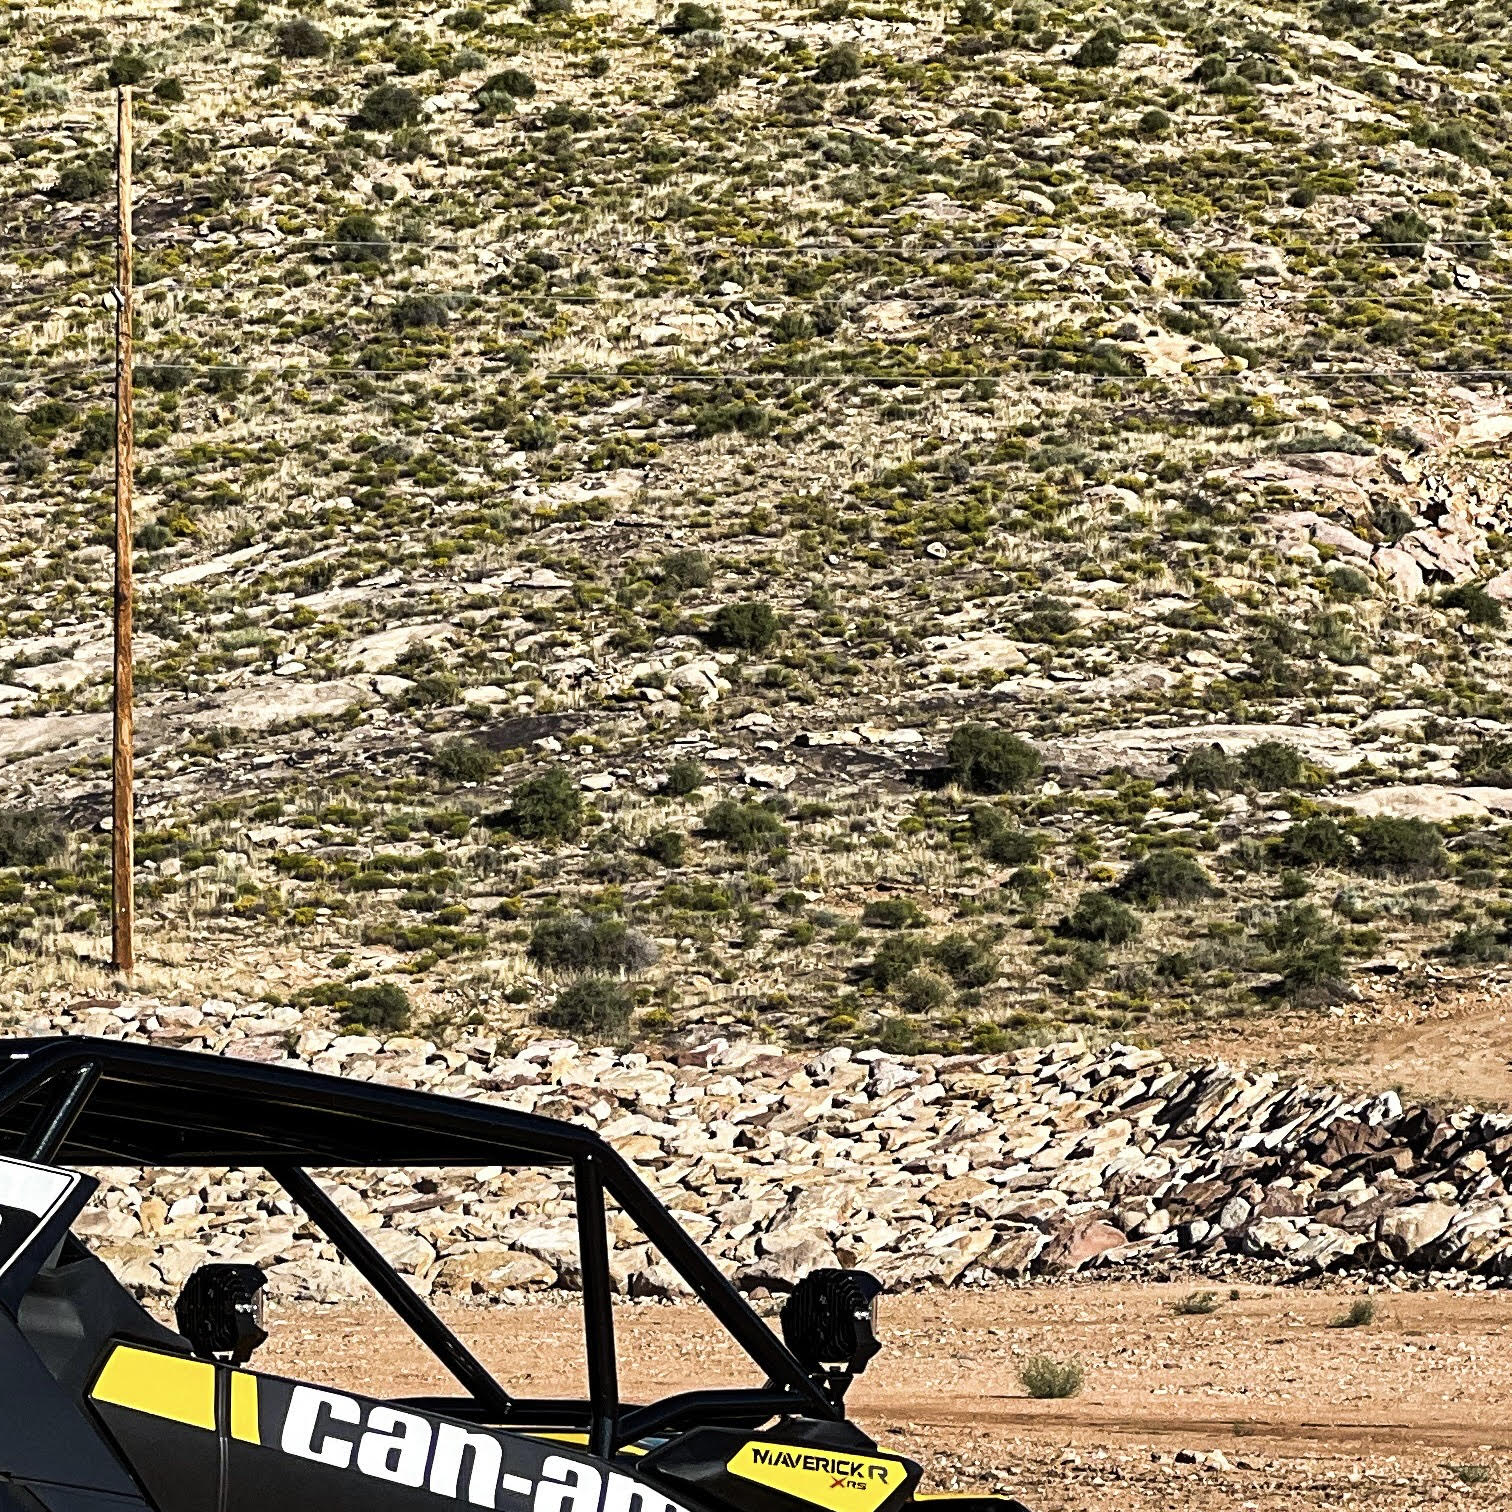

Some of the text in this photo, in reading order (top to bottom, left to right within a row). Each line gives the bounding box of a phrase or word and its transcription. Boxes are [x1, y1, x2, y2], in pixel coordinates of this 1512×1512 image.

[752, 1448, 889, 1485] MAVERICK R
[829, 1475, 867, 1491] XRS
